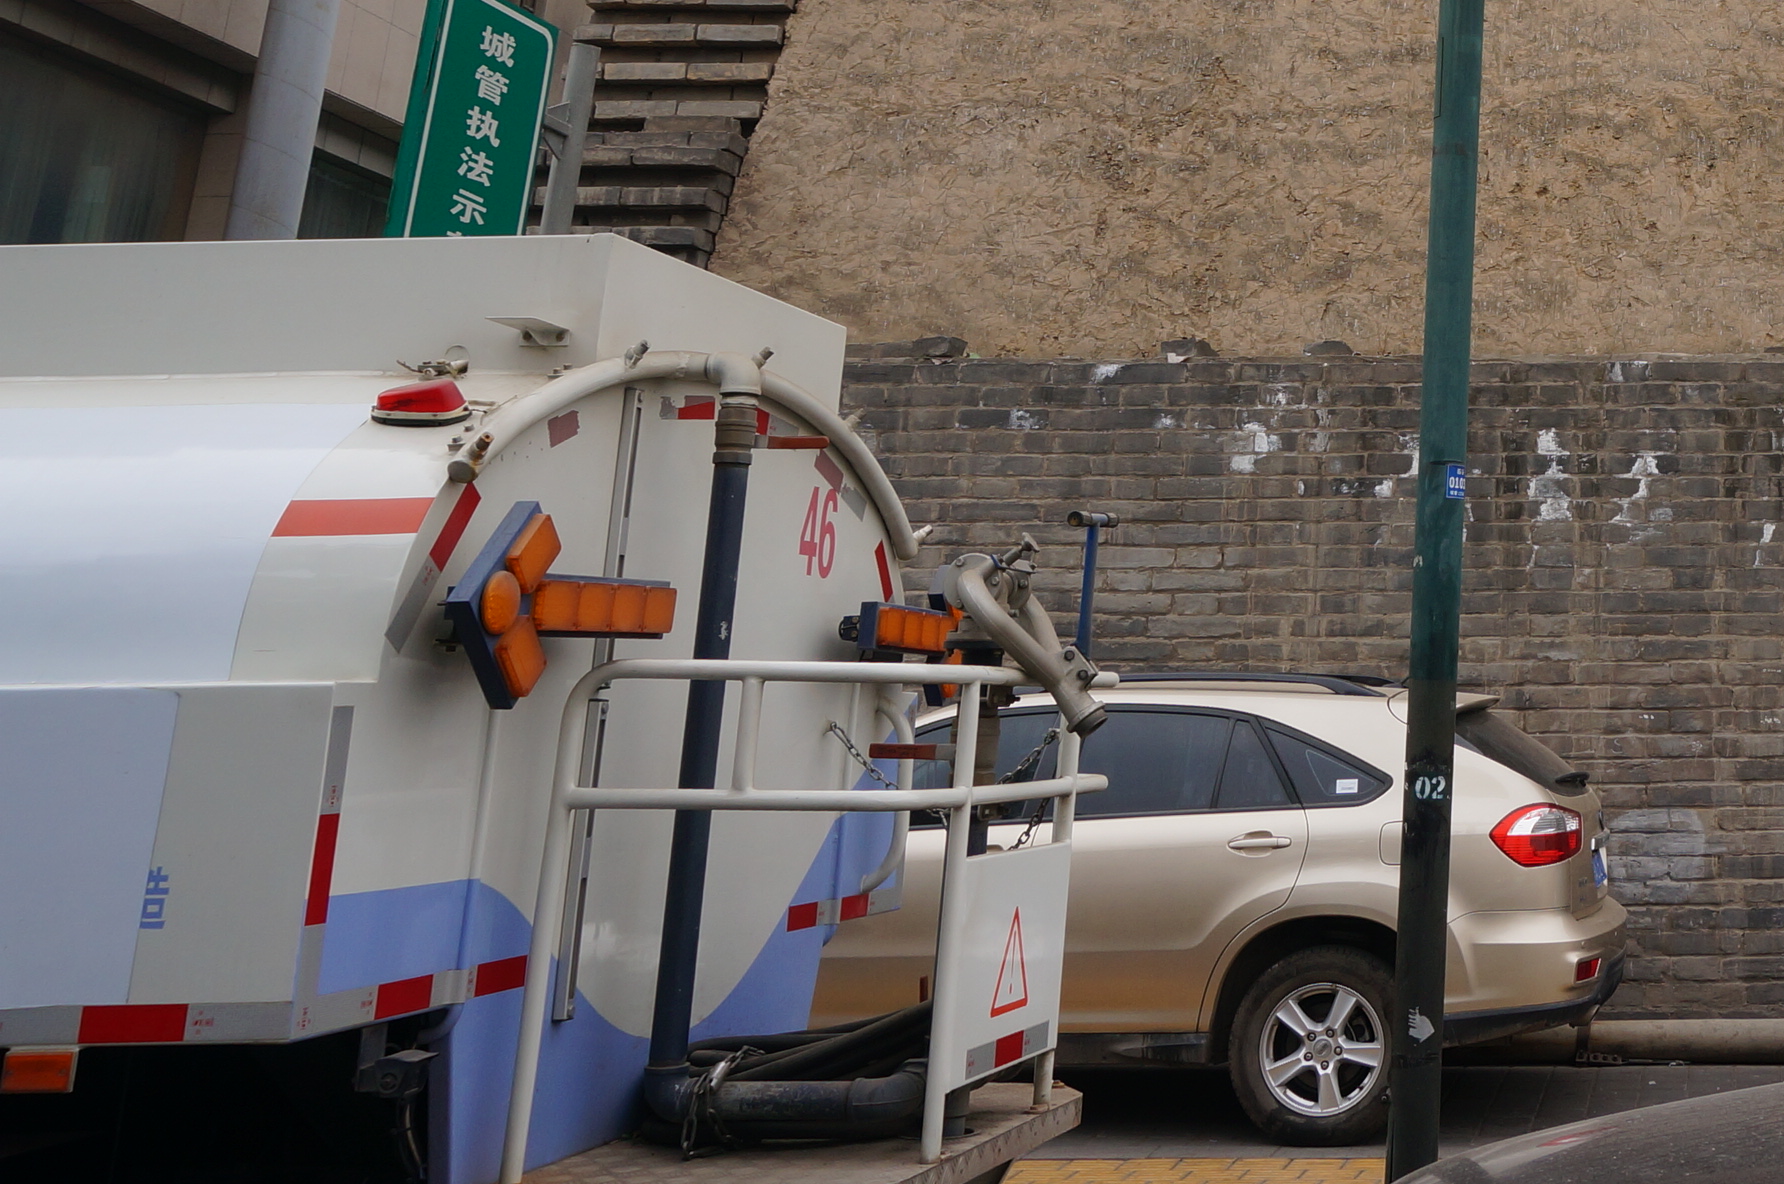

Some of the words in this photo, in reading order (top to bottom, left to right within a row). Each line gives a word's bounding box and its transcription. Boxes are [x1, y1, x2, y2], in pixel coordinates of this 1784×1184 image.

[446, 25, 518, 237] 城管执法示
[798, 485, 839, 580] 46
[1415, 775, 1446, 800] 02
